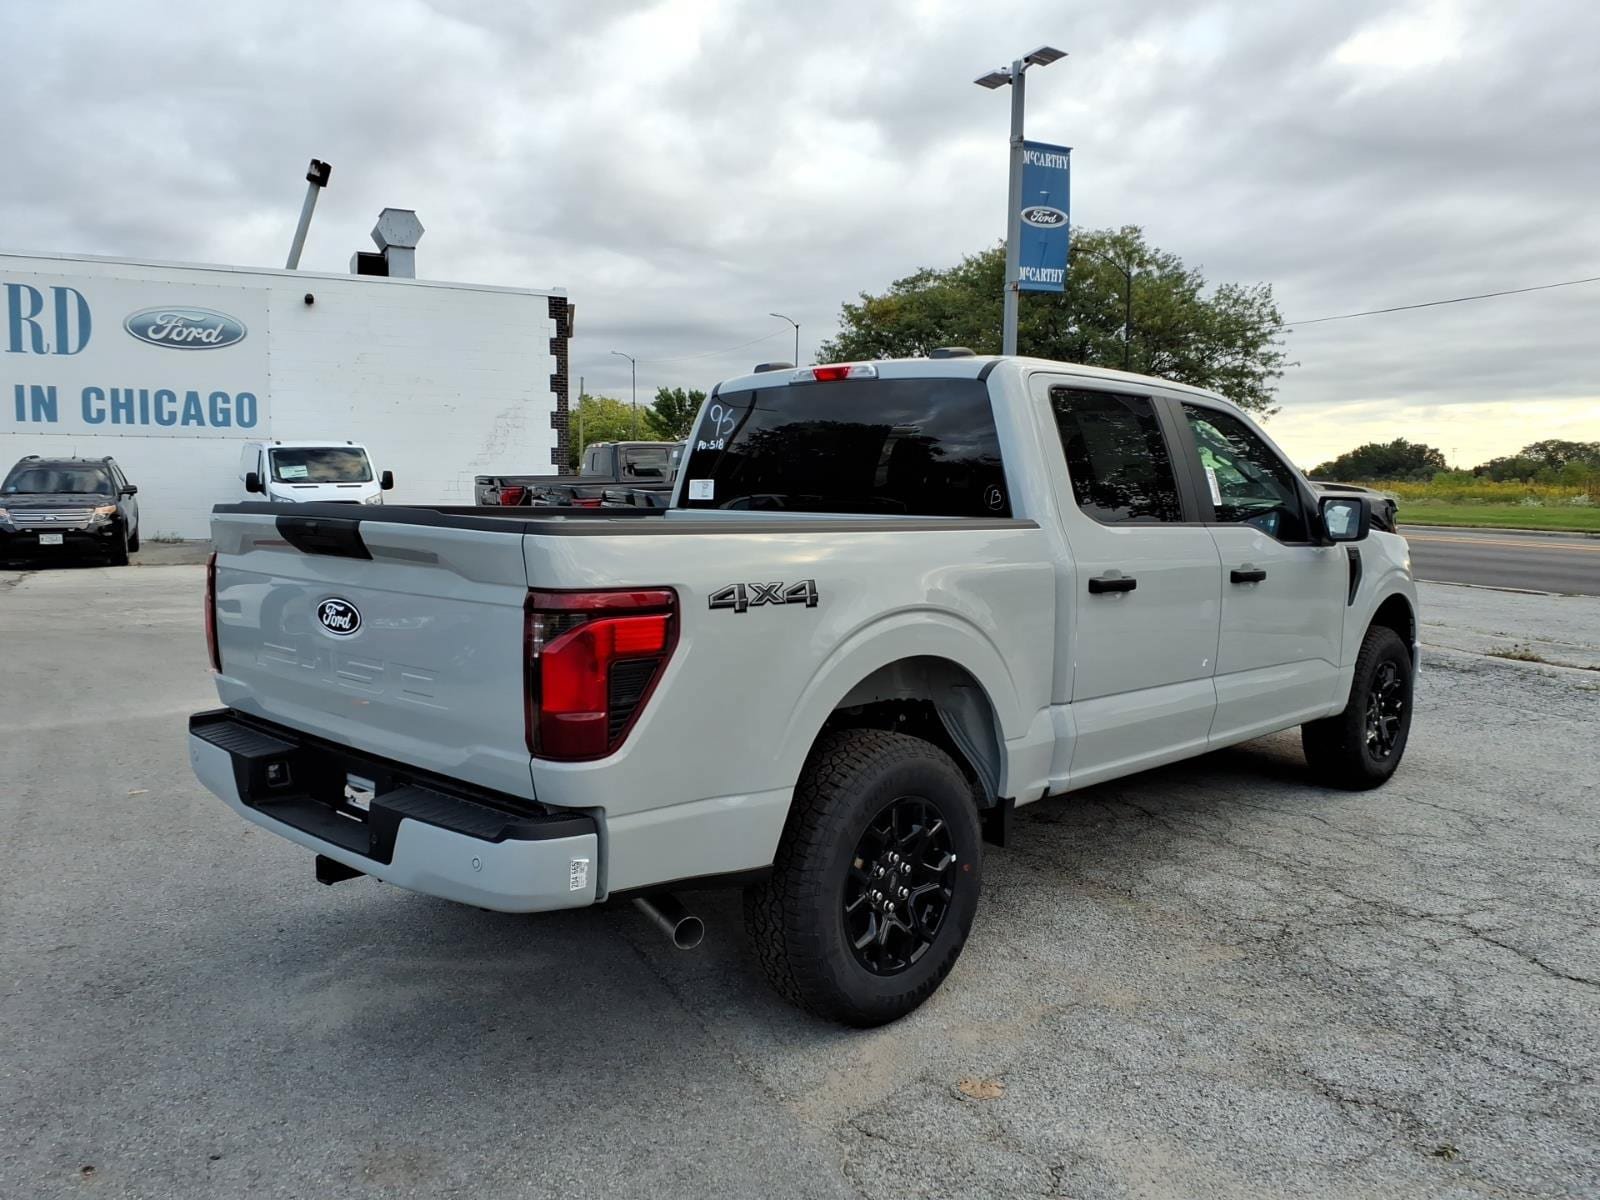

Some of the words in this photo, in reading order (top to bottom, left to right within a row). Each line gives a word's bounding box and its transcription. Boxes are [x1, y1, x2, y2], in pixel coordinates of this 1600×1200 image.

[1023, 150, 1069, 170] McCARTHY
[1030, 209, 1057, 224] Ford
[1019, 266, 1064, 283] McCARTHY
[3, 282, 92, 355] RD
[147, 313, 225, 344] Ford
[14, 384, 58, 423] IN
[81, 386, 258, 428] CHICAGO
[710, 404, 735, 437] 95
[322, 602, 352, 629] Ford
